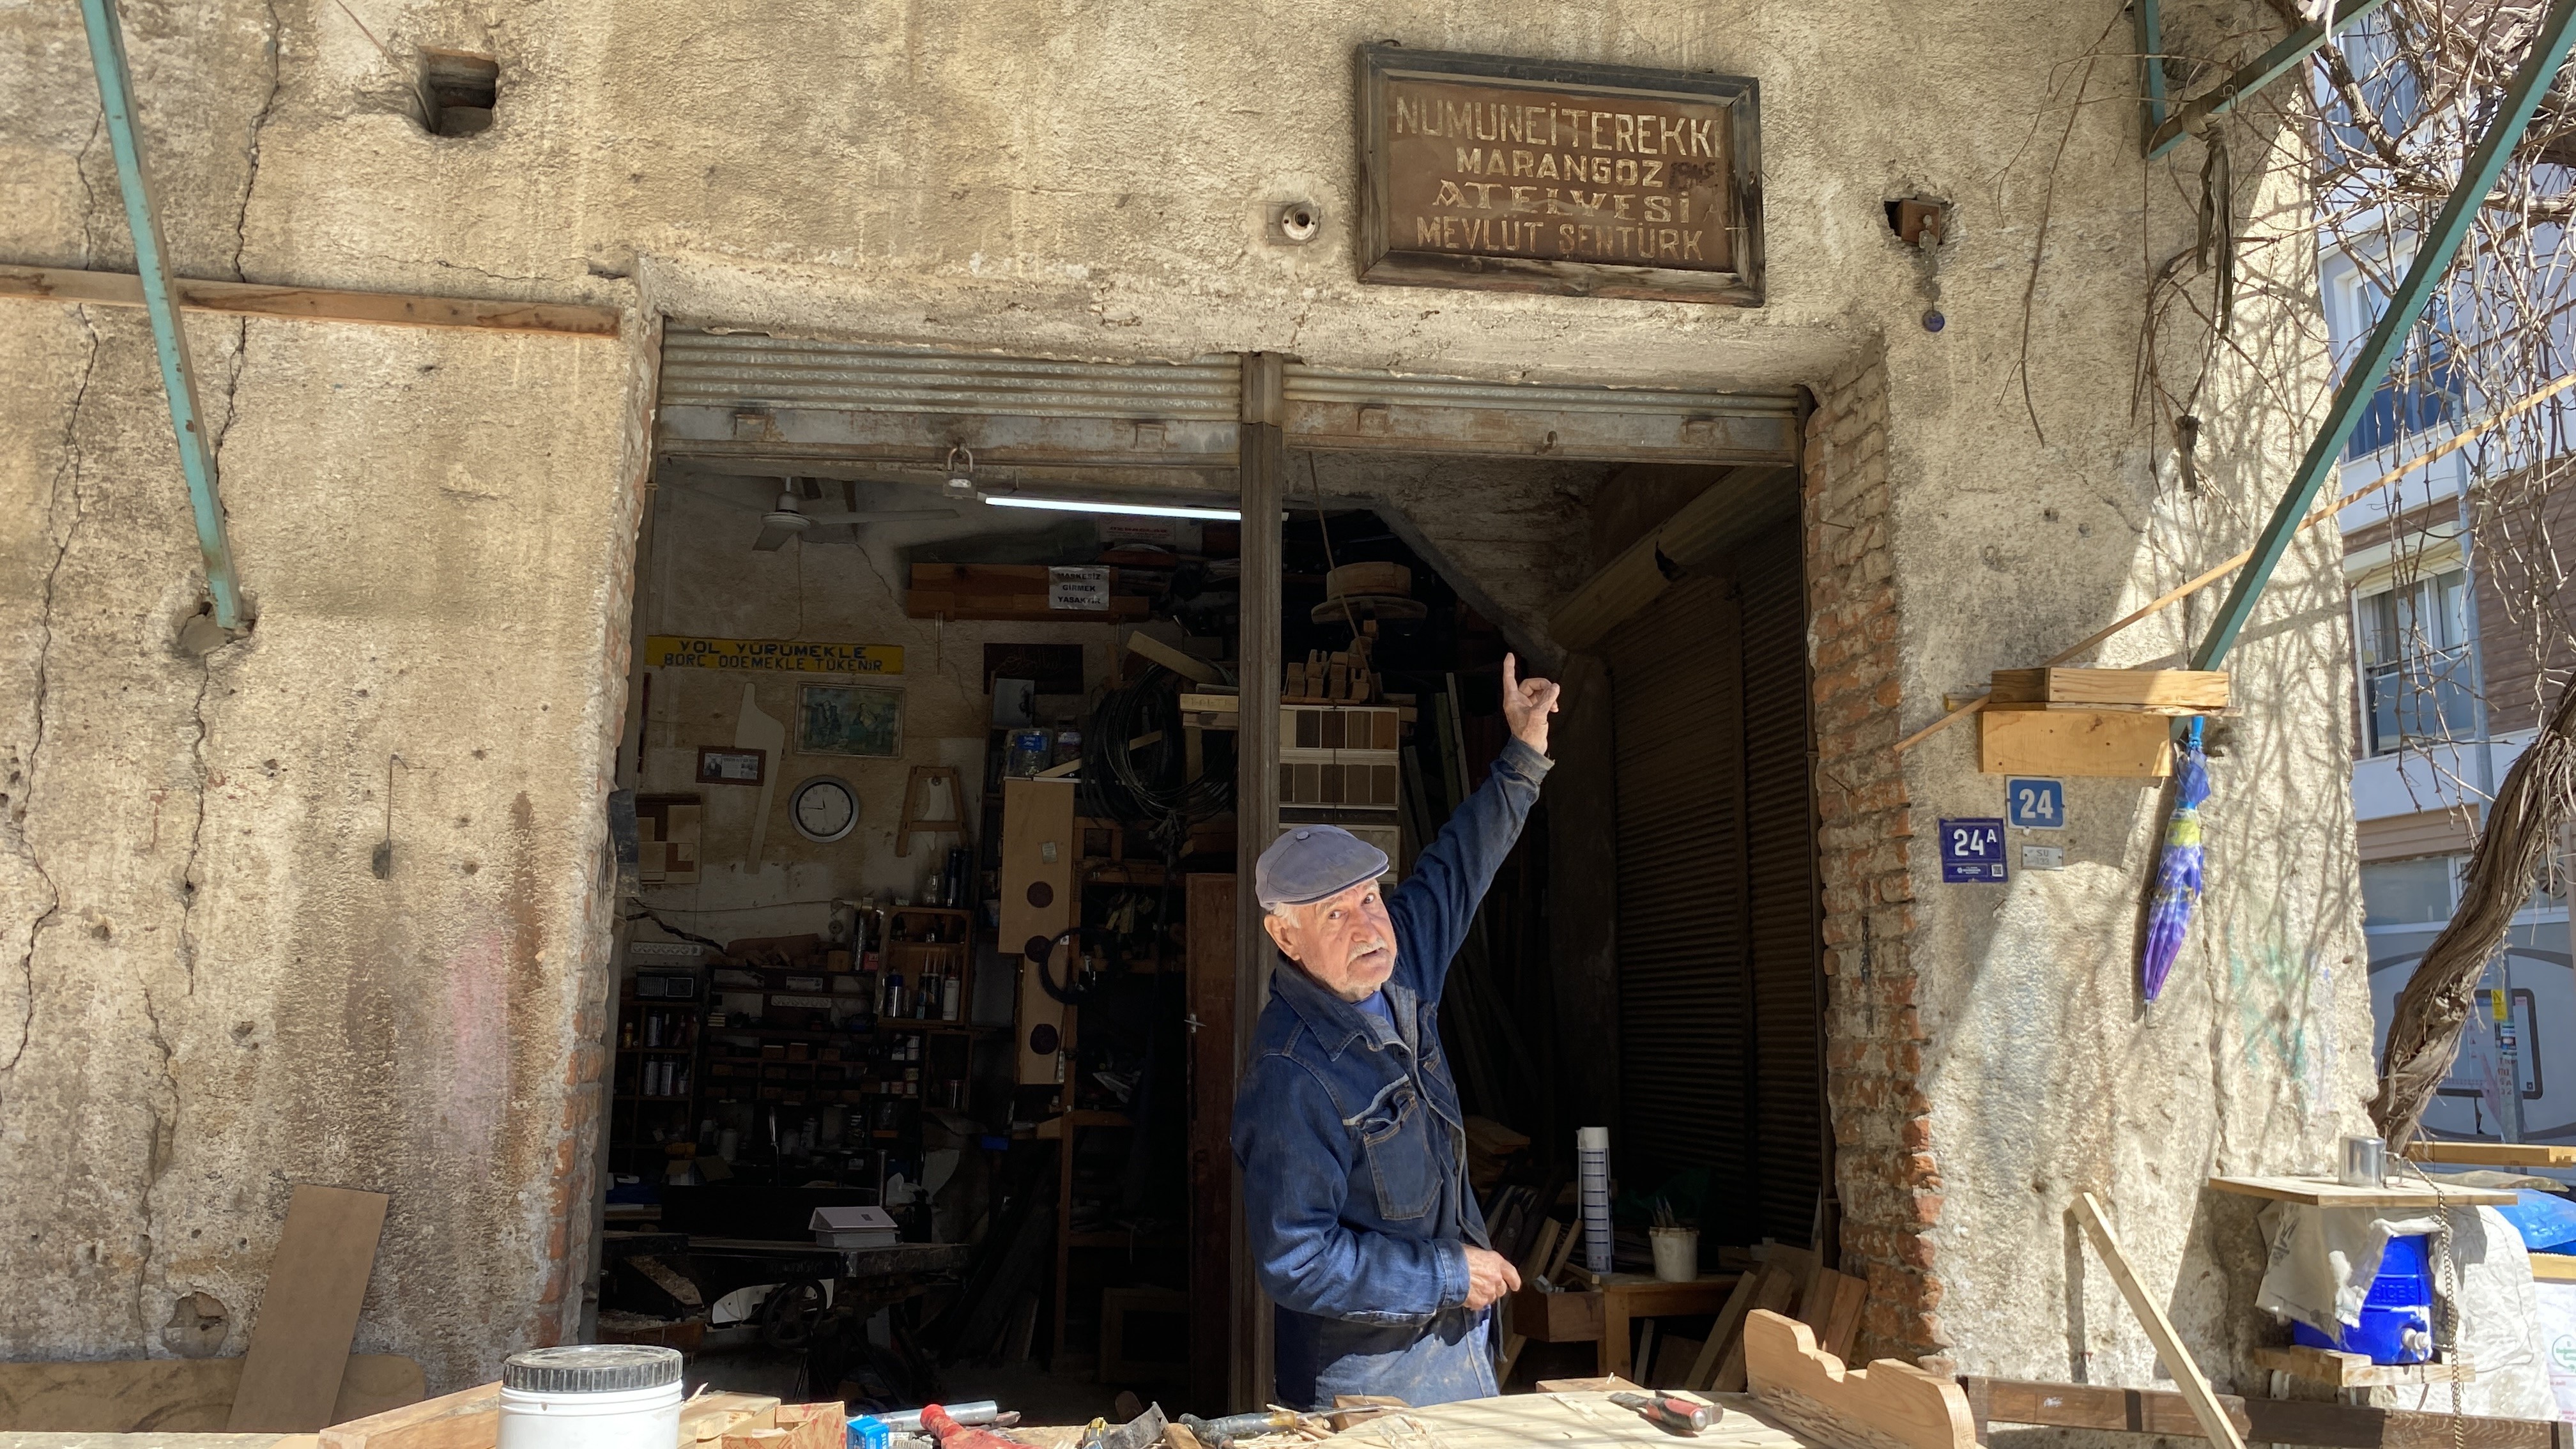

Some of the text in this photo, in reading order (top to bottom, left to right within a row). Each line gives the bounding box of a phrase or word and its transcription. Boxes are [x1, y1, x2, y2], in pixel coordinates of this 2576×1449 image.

[1456, 146, 1663, 188] MARANGOZ
[1432, 179, 1690, 224] ATELYESİ
[1416, 213, 1544, 253] MEVLÜT
[679, 640, 867, 660] YOL YÜRÜMEKLE
[2019, 788, 2053, 820] 24
[2035, 848, 2050, 857] SU
